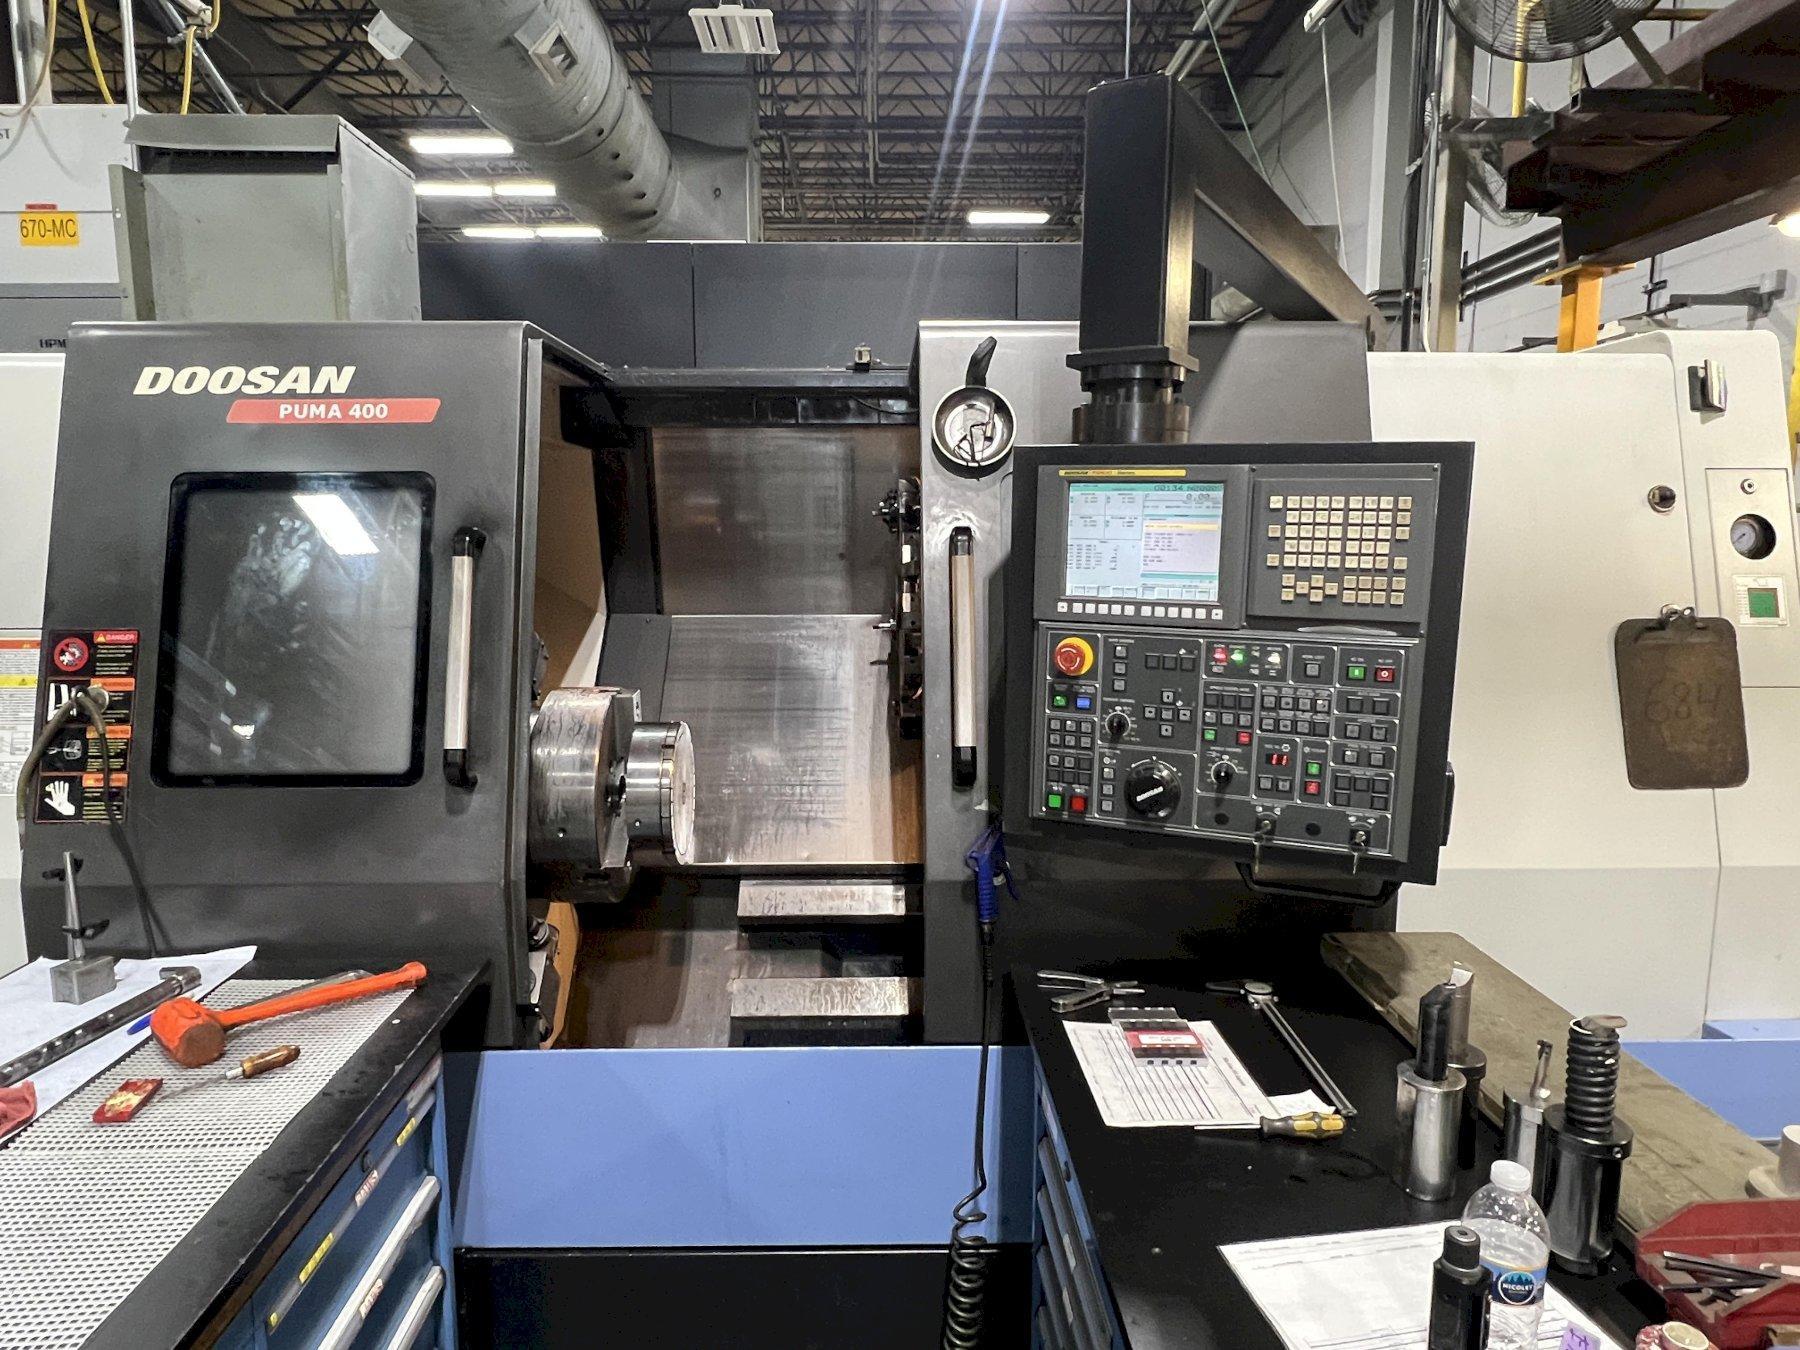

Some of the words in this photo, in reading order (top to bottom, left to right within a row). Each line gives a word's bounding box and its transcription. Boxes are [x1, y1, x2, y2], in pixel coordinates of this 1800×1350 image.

[20, 219, 77, 238] 670-MC
[133, 366, 357, 395] DOOSAN
[279, 404, 342, 419] PUMA
[349, 404, 388, 418] 400
[1644, 678, 1722, 722] 684
